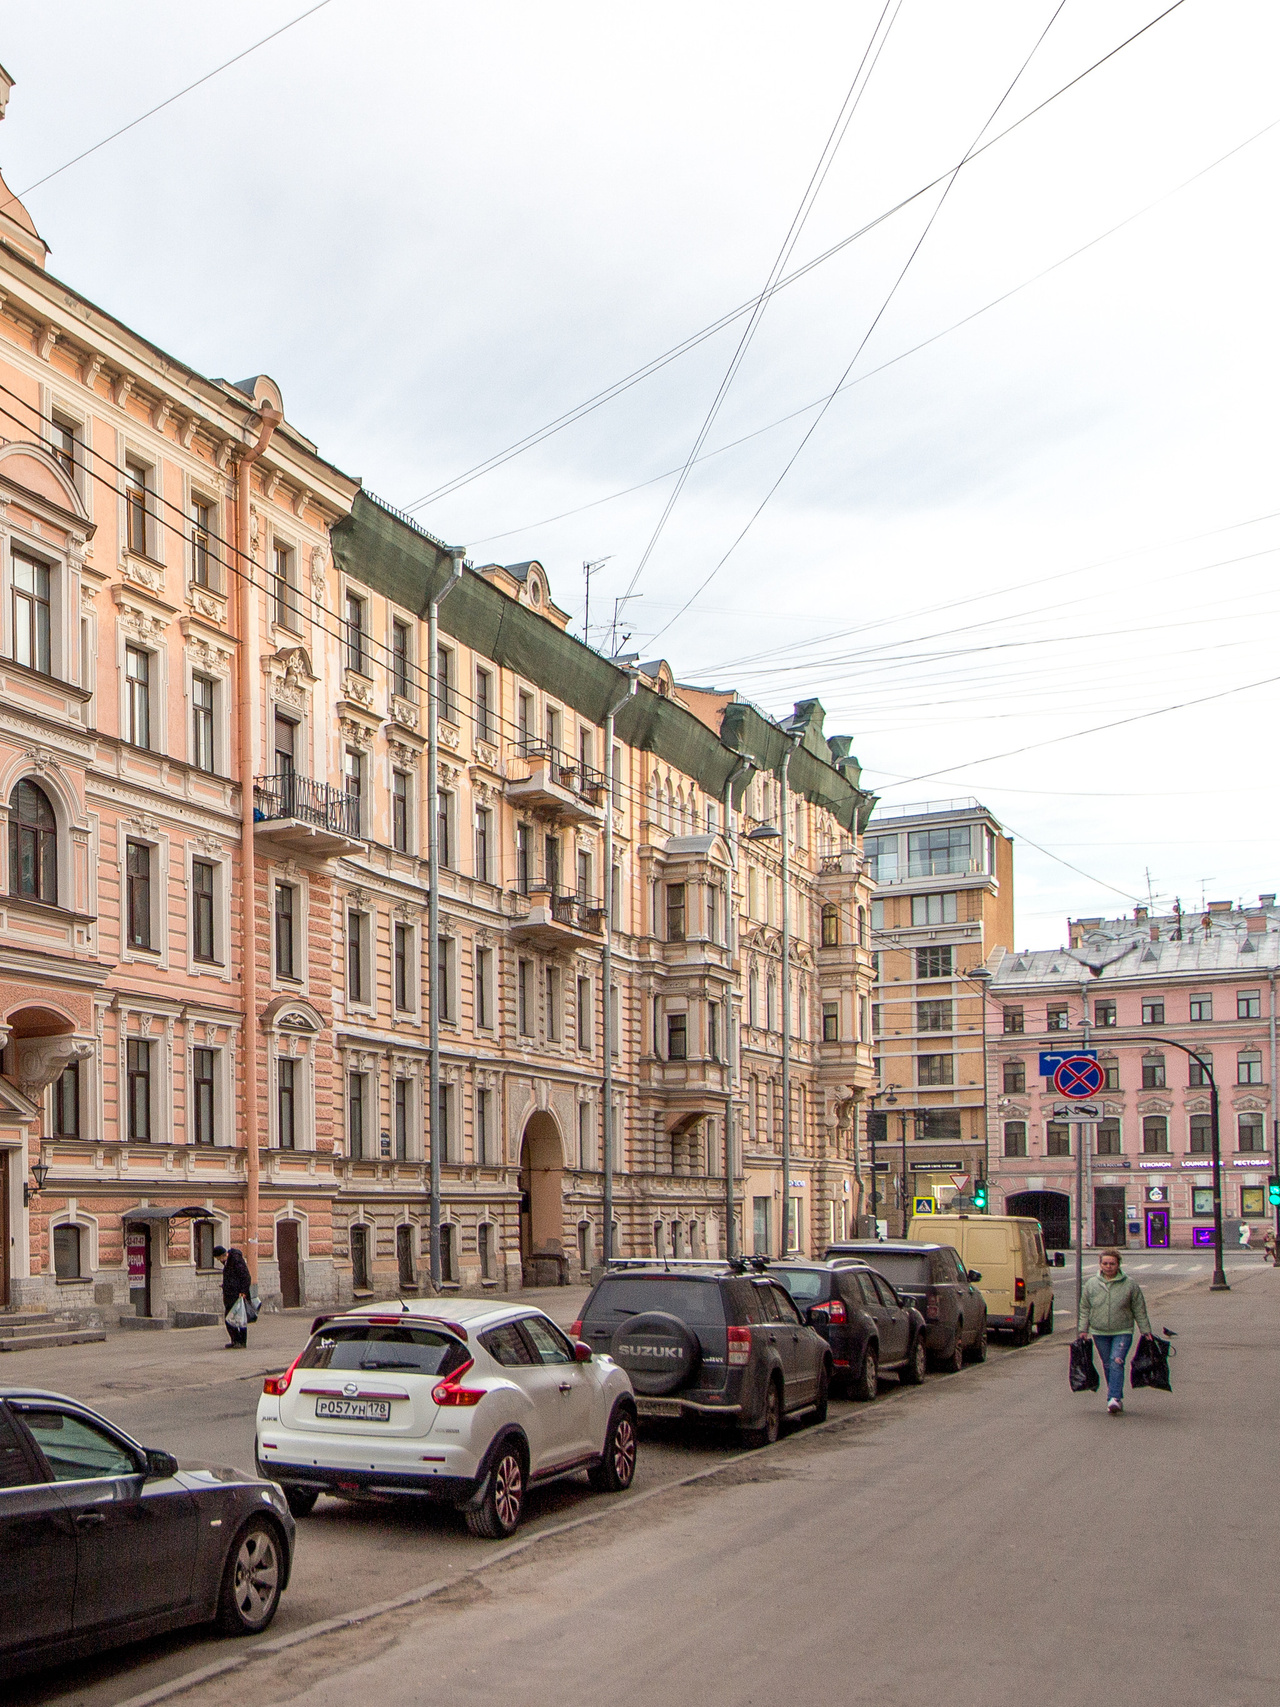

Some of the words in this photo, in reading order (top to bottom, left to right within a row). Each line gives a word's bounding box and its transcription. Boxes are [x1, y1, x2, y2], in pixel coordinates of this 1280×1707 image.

[1139, 1161, 1171, 1169] FEROMON
[1181, 1160, 1209, 1168] LOUNGE
[1233, 1159, 1271, 1167] РЕСТОБАР
[128, 1254, 144, 1267] РЕНДА
[619, 1345, 683, 1358] SUZUKI
[368, 1403, 386, 1413] 178
